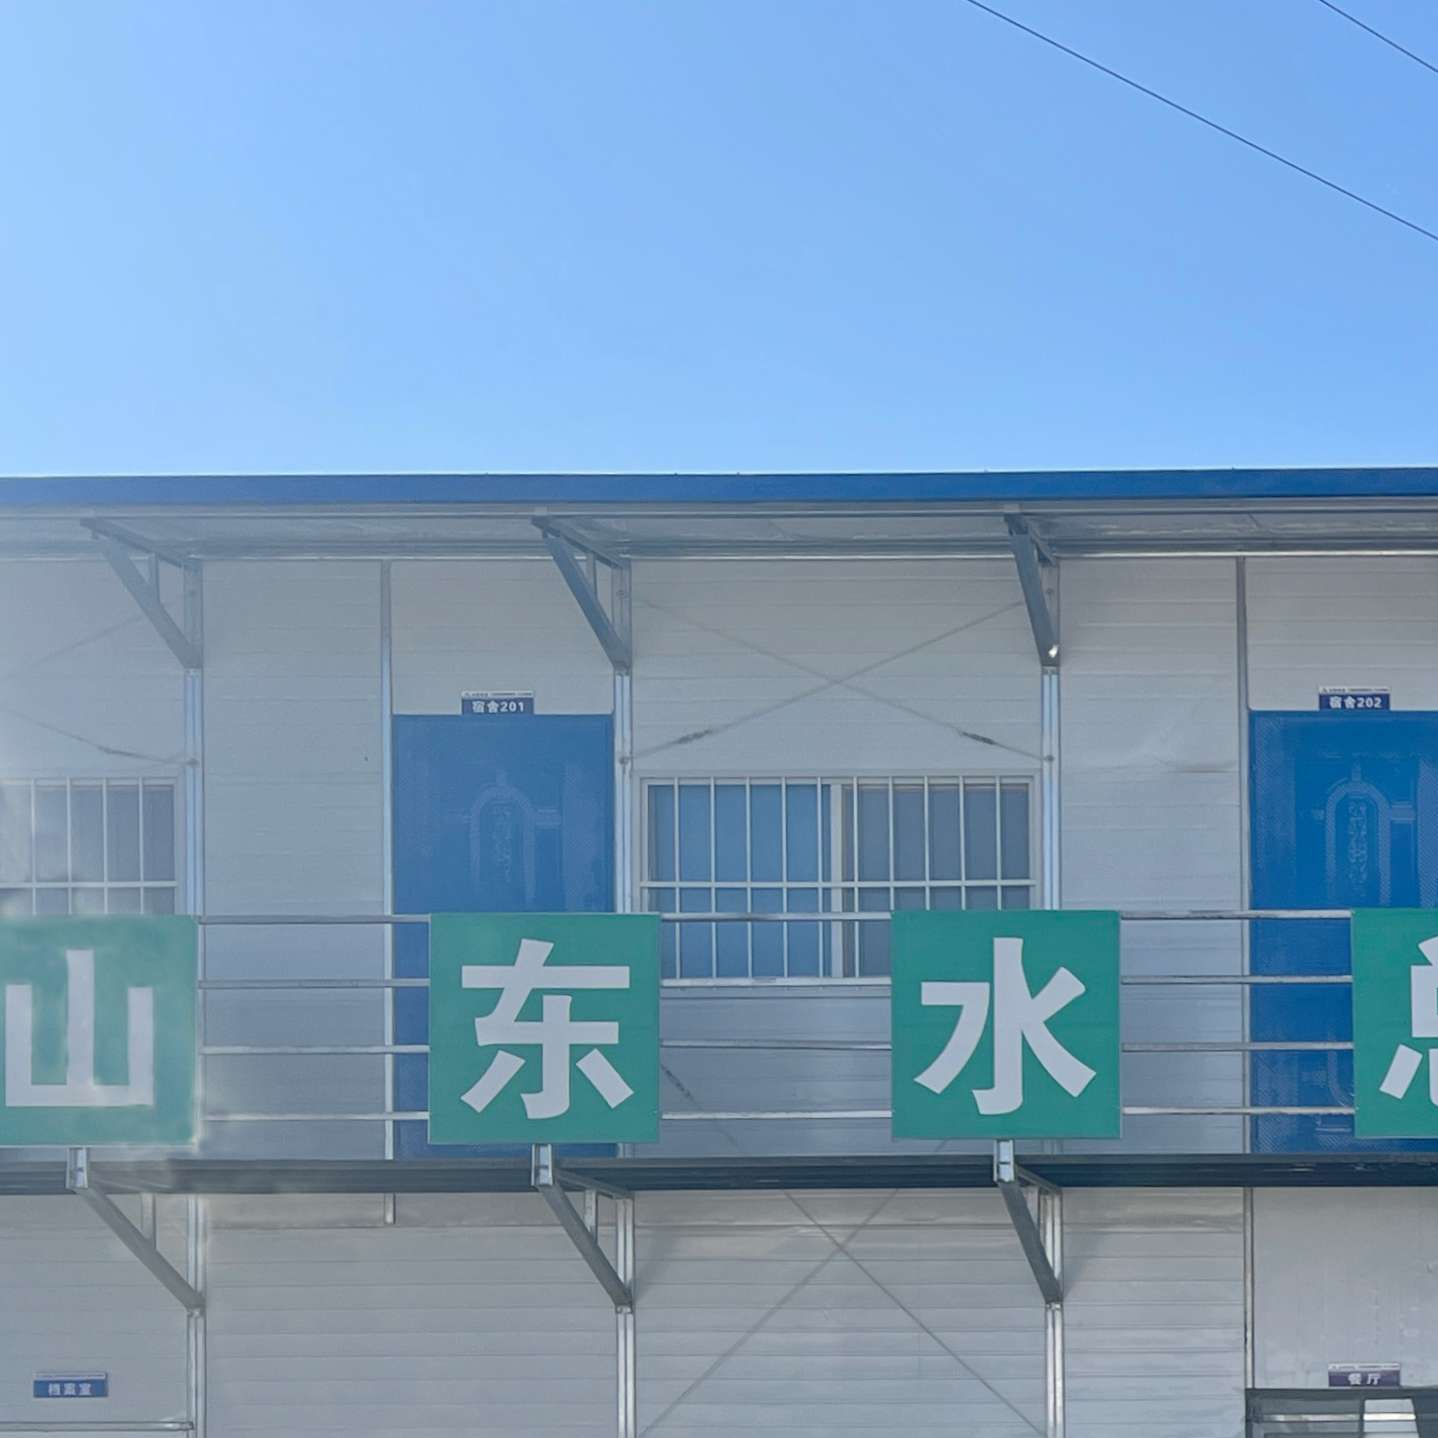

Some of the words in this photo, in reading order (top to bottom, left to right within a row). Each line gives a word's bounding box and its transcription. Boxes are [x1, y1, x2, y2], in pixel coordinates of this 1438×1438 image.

[472, 700, 526, 714] 宿舍201
[1329, 696, 1383, 709] 宿舍202
[1348, 1373, 1381, 1385] 餐厅
